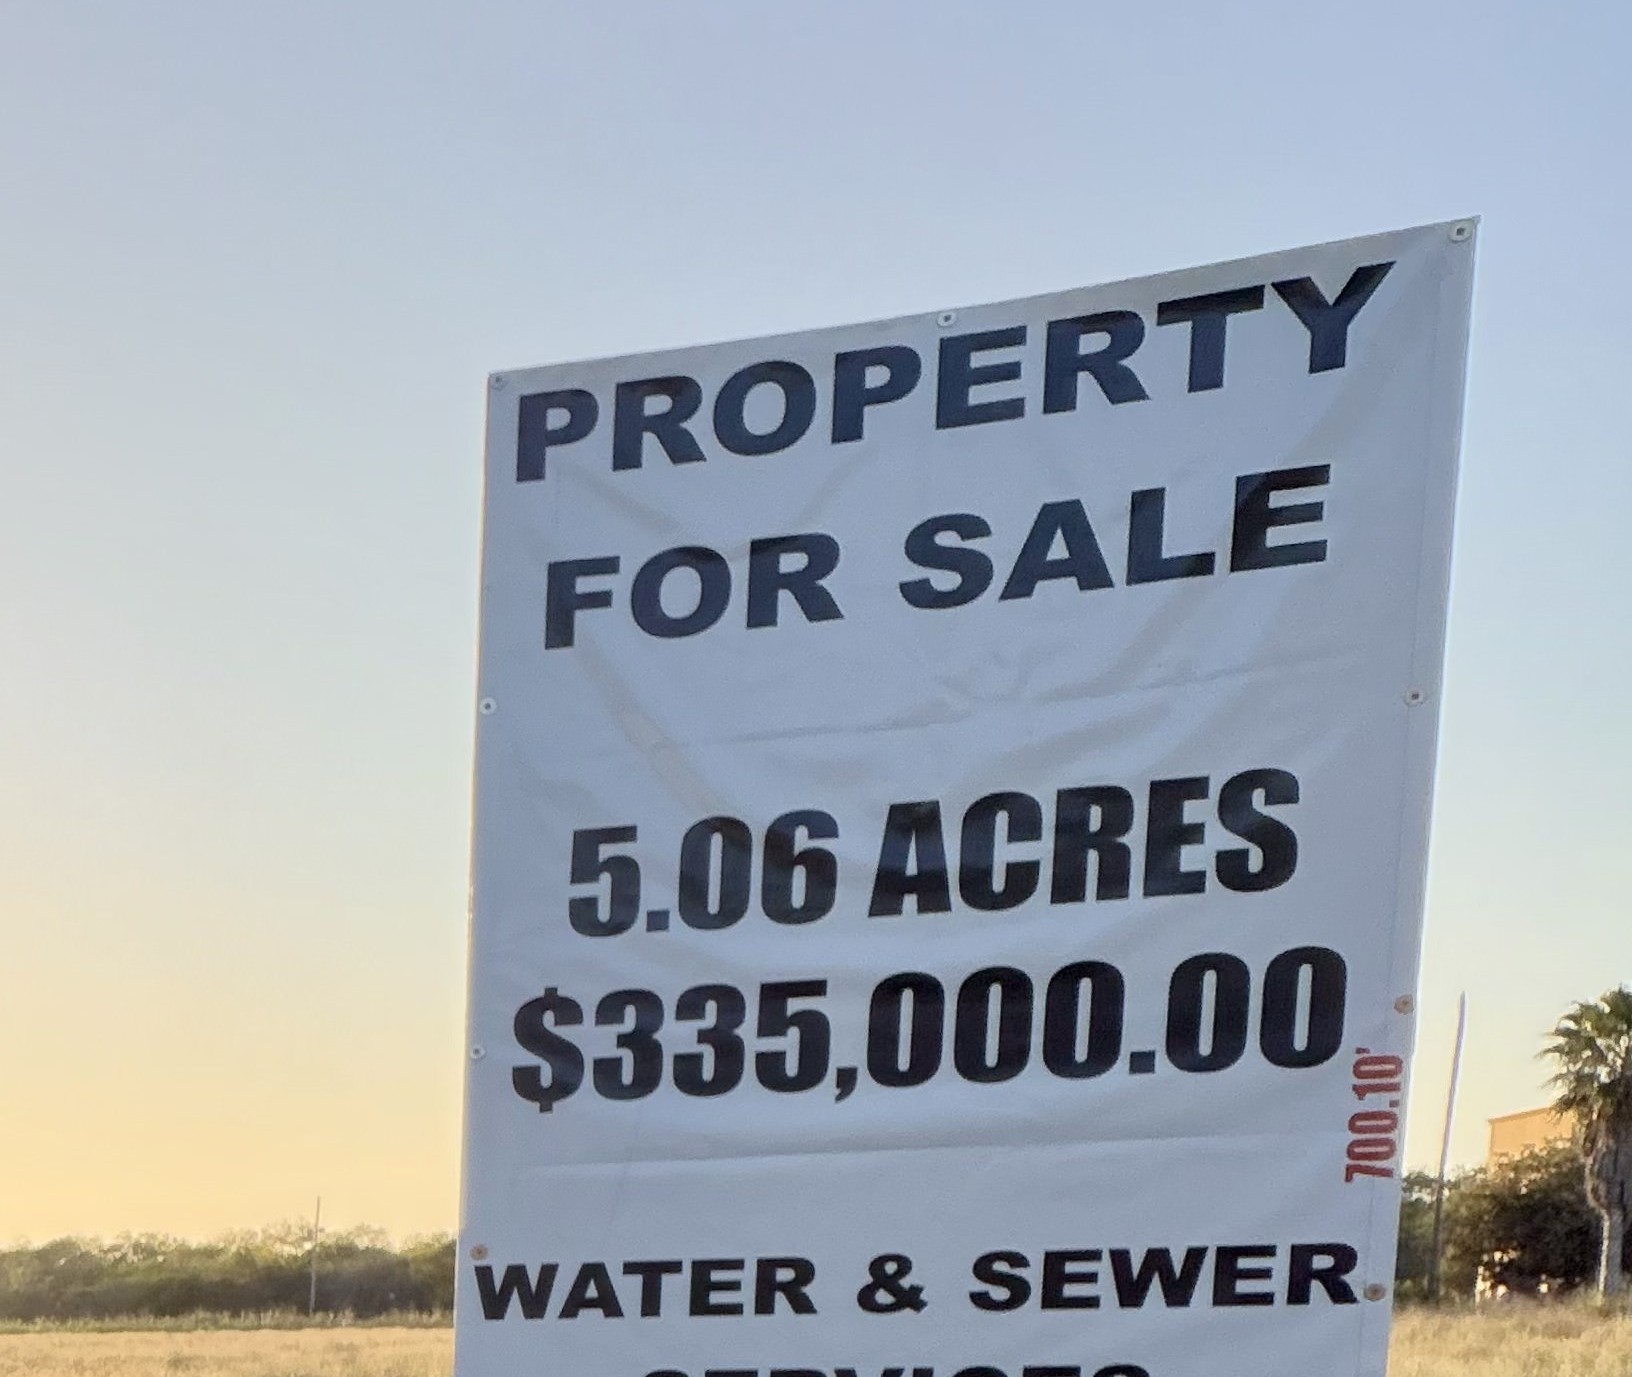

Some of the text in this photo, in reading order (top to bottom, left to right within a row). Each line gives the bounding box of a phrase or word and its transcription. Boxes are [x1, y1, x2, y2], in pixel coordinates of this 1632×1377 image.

[514, 260, 1395, 483] PROPERTY
[543, 463, 1332, 651] FOR SALE
[567, 767, 1301, 938] 5.06 ACRES
[510, 944, 1349, 1114] $335,000.00
[475, 1243, 1362, 1321] WATER & SEWER
